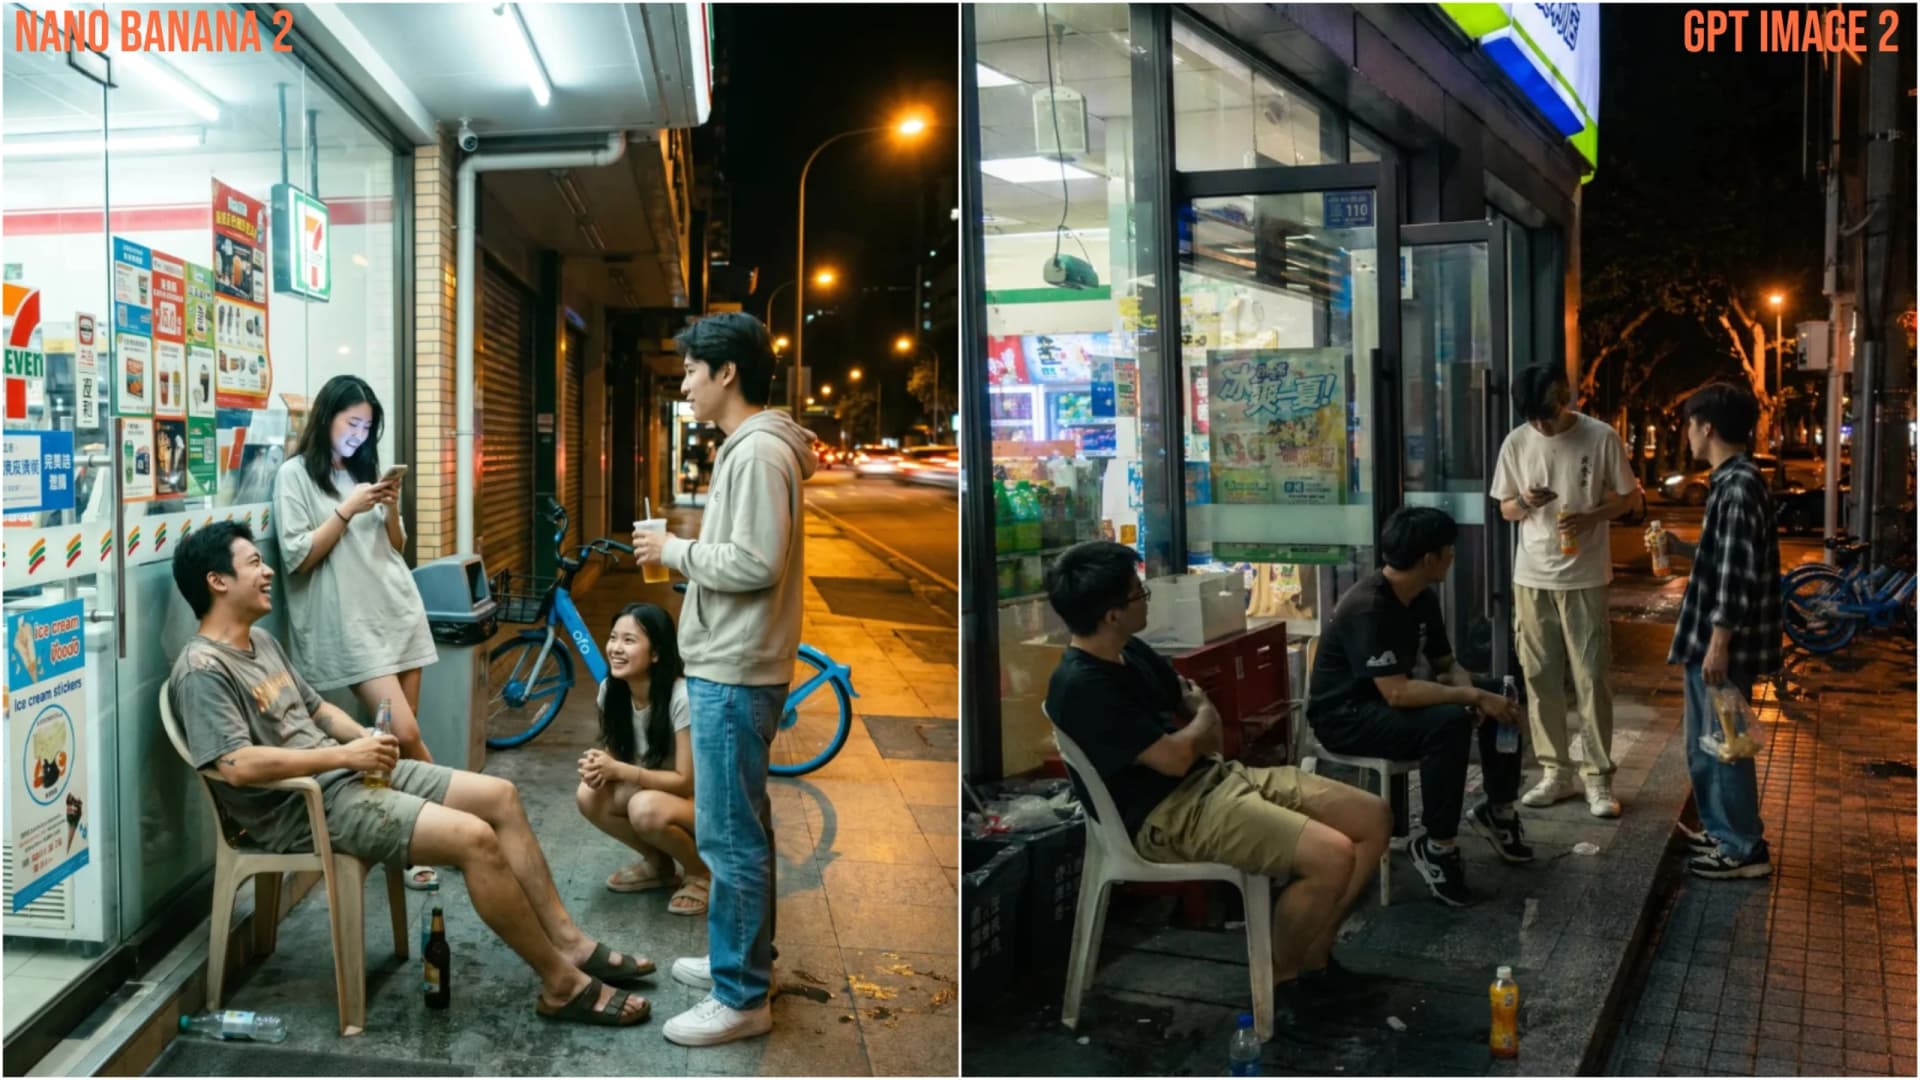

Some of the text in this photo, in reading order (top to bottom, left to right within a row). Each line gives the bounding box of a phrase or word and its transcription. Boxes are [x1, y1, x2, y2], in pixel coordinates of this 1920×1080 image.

[1346, 203, 1368, 217] 110
[572, 630, 590, 655] ofo
[28, 689, 52, 707] cream
[54, 678, 82, 697] stickers
